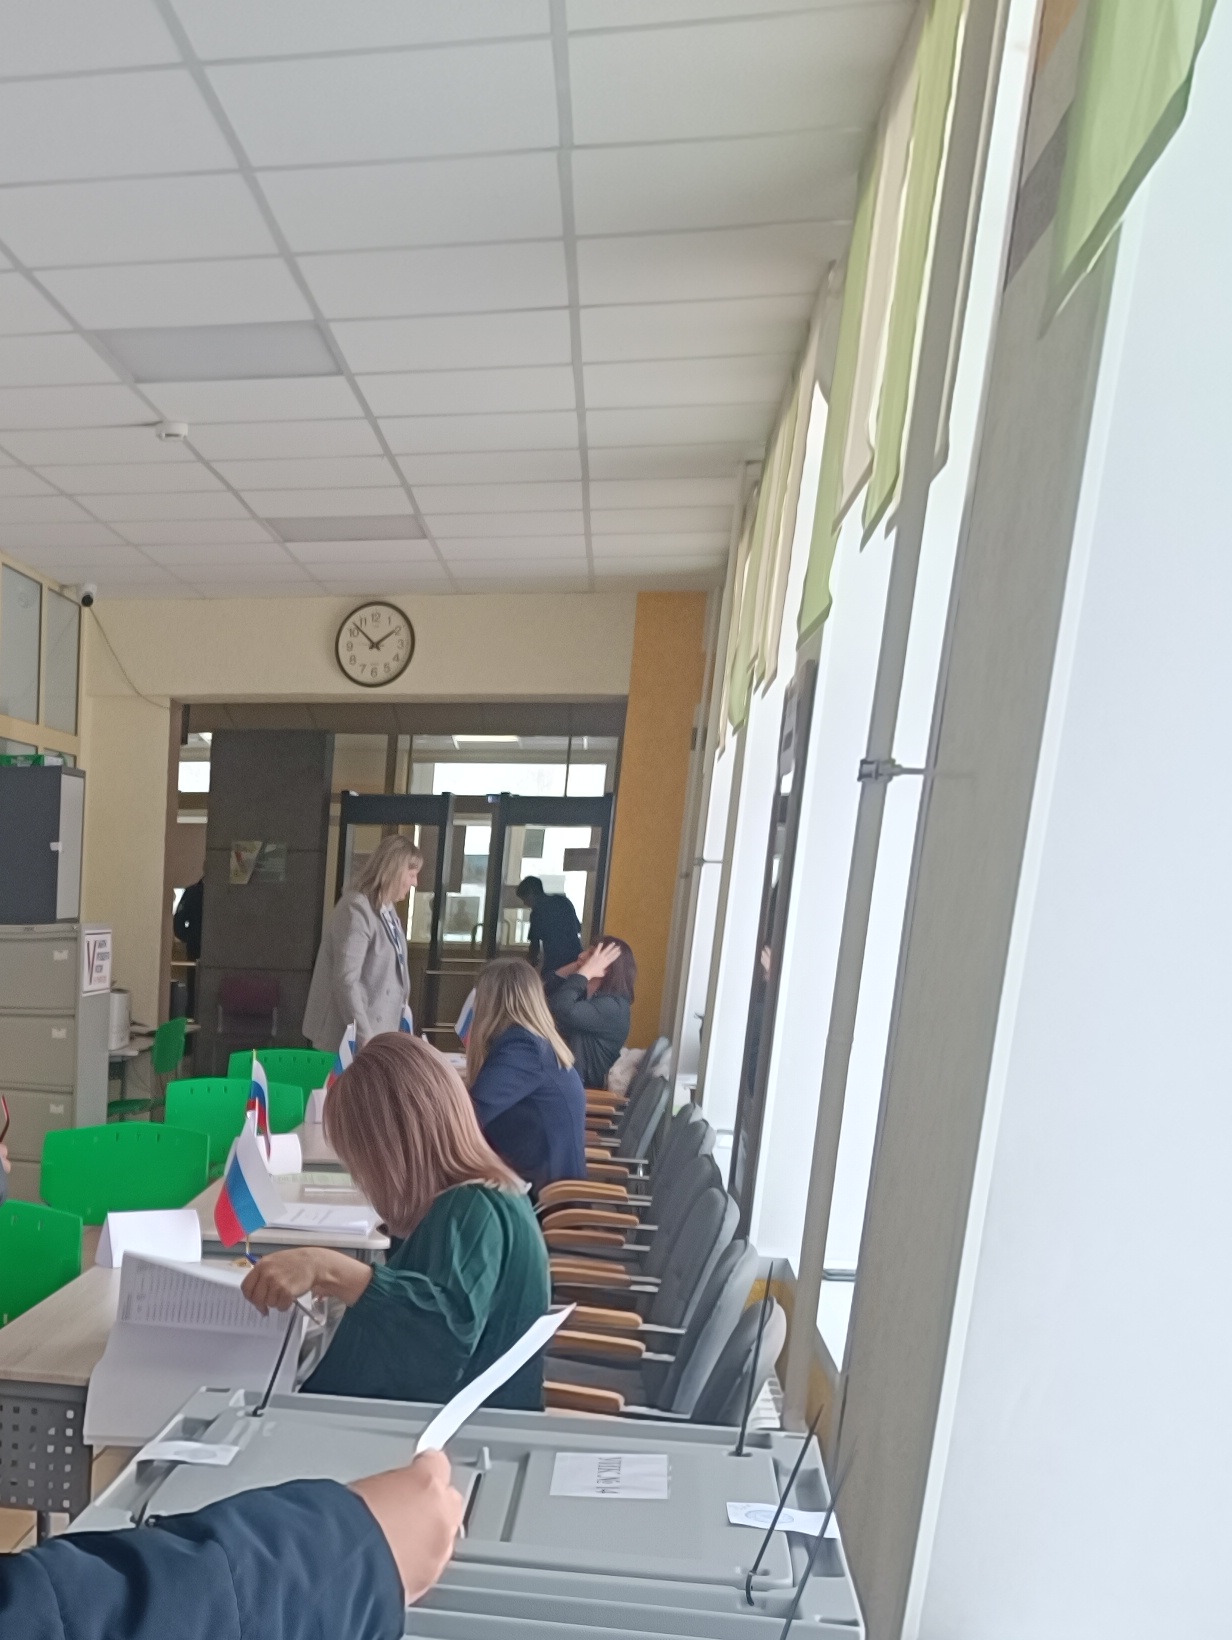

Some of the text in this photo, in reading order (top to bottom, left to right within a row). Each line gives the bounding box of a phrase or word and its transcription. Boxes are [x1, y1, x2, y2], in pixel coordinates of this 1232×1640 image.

[360, 617, 367, 627] 11
[371, 612, 381, 623] 12
[349, 628, 359, 638] 10
[395, 626, 401, 635] 2
[346, 641, 353, 651] 9
[398, 639, 404, 649] 3
[349, 655, 356, 665] 8
[392, 653, 399, 662] 4
[359, 663, 367, 674] 7
[371, 667, 377, 678] 6
[384, 663, 390, 673] 5
